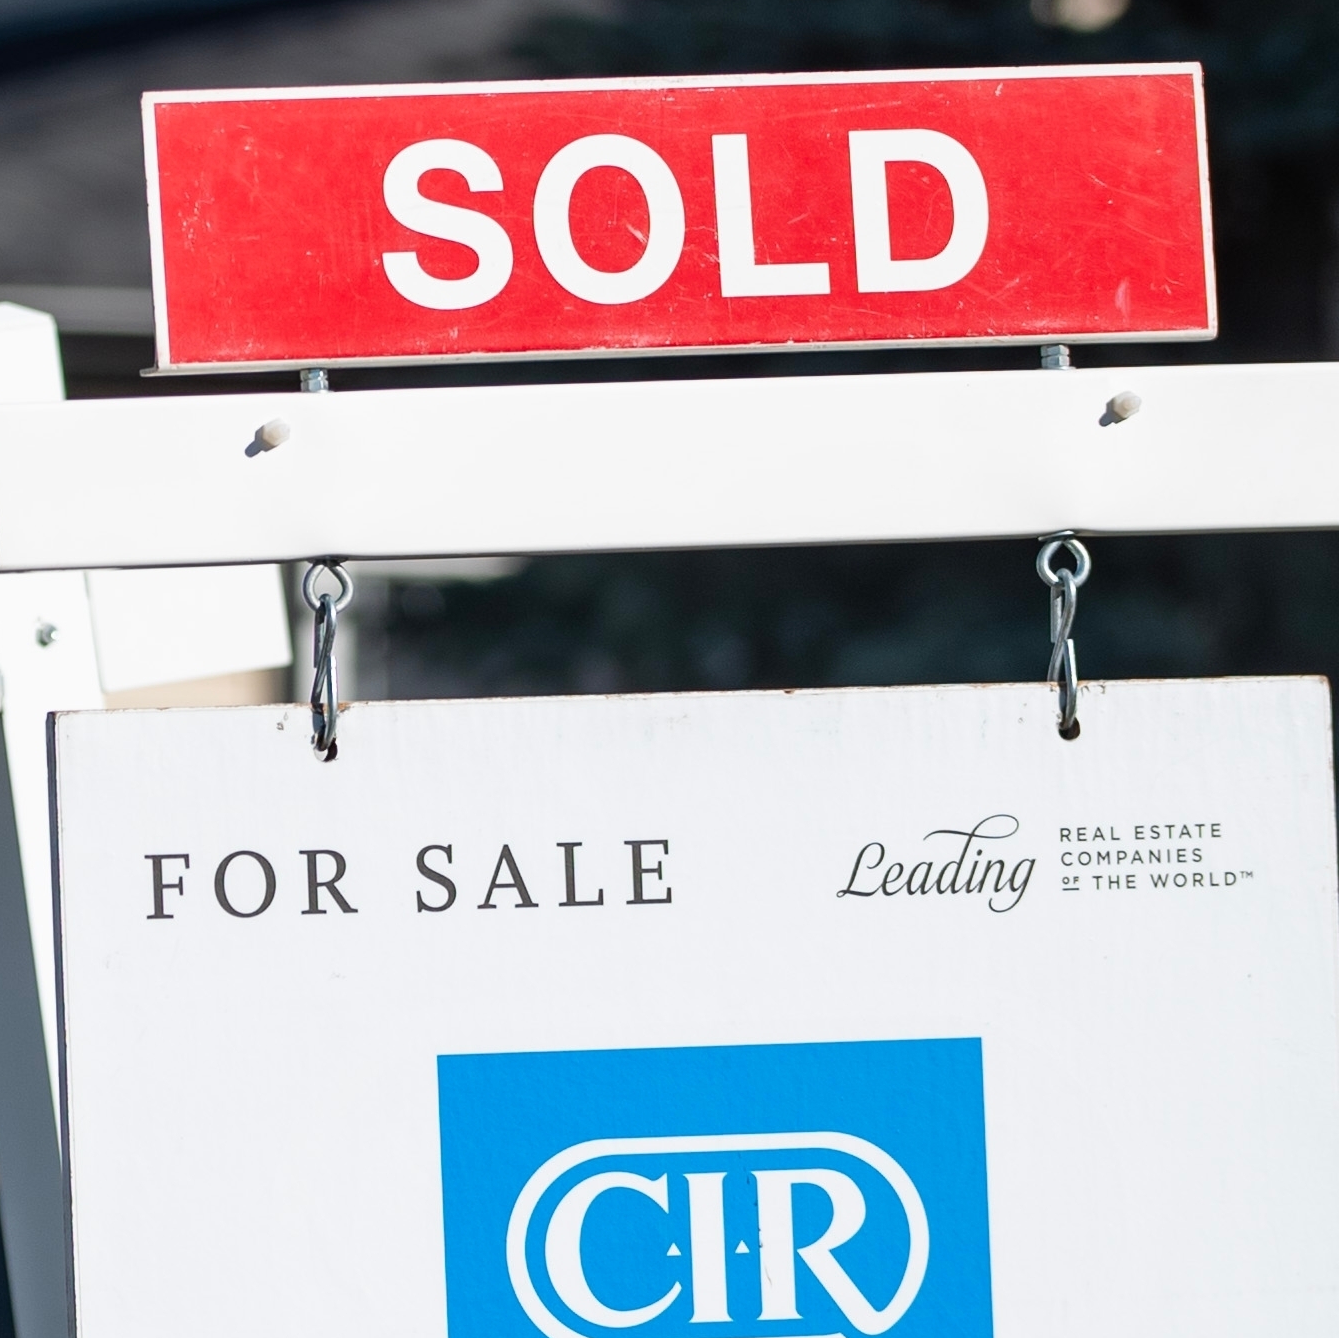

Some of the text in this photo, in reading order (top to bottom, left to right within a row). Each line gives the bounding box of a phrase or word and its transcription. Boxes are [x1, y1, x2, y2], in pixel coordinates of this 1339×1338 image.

[383, 129, 989, 309] SOLD
[1060, 823, 1221, 842] REAL ESTATE
[1061, 848, 1202, 866] COMPANIES
[144, 839, 672, 920] FOR SALE
[836, 814, 1036, 913] Leading
[1062, 876, 1080, 891] OF
[1092, 875, 1136, 890] THE
